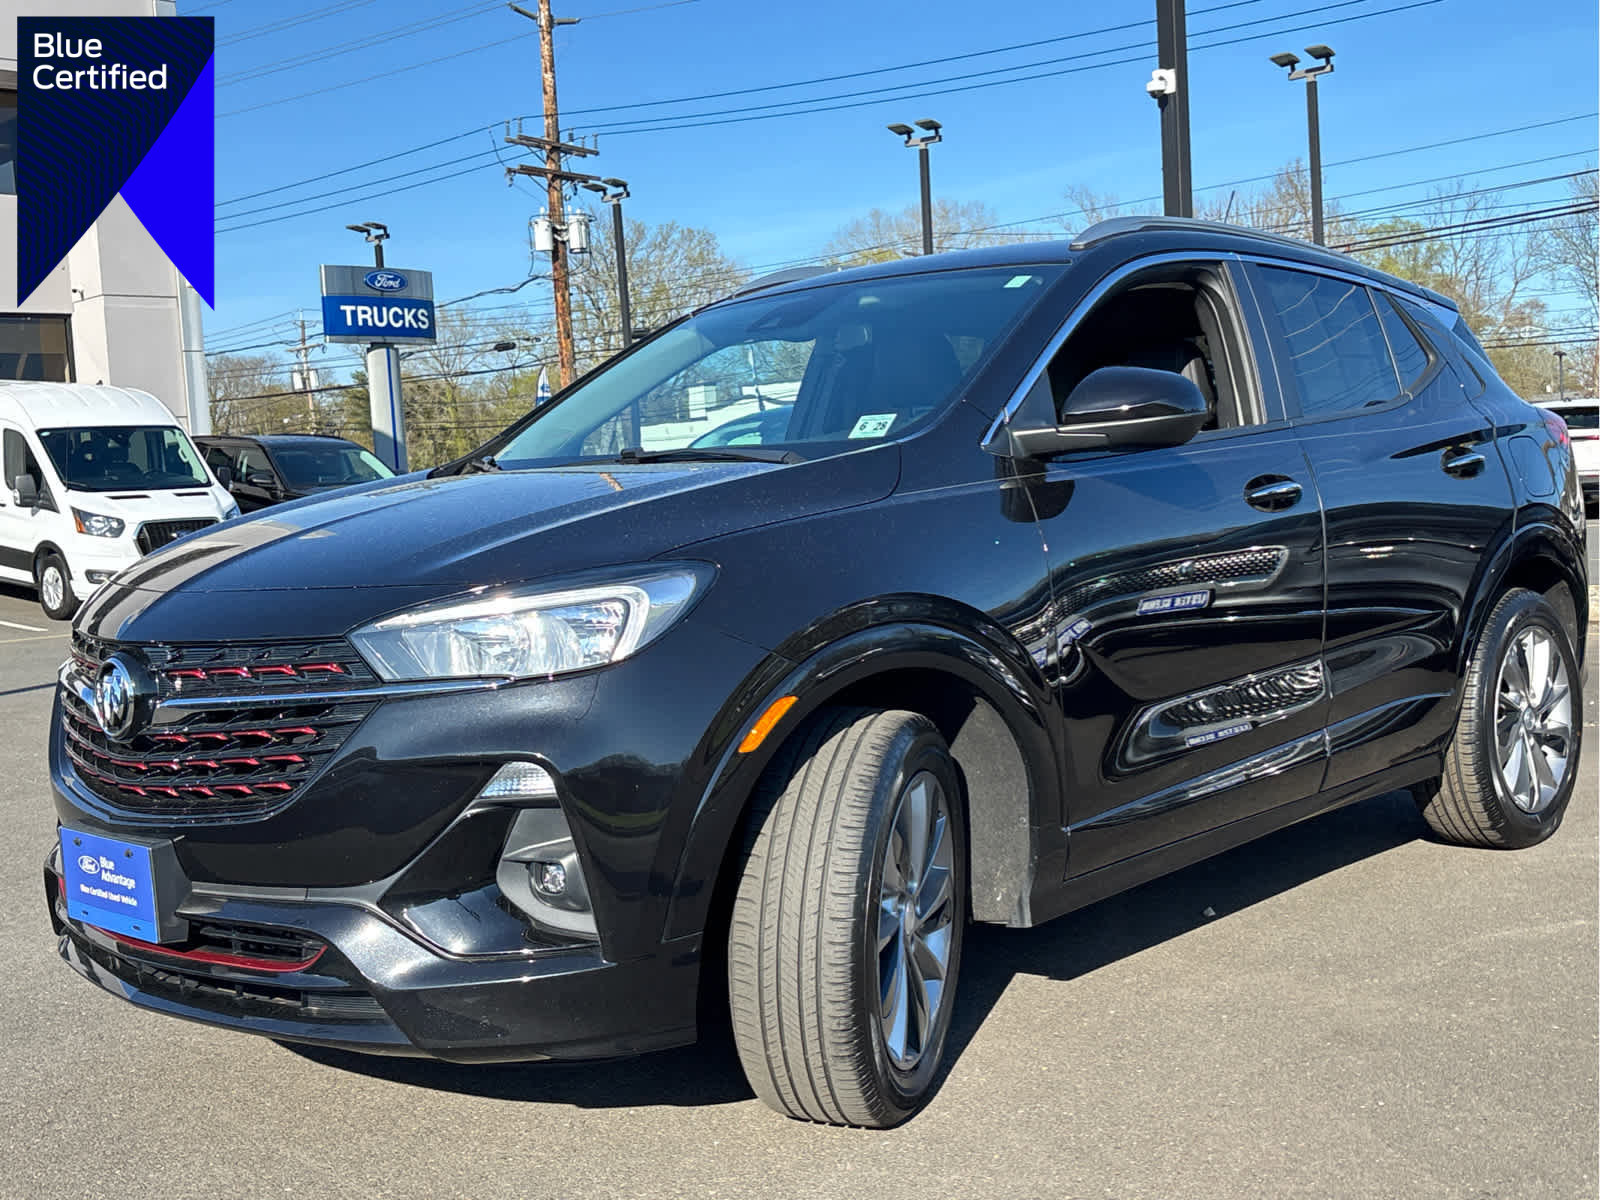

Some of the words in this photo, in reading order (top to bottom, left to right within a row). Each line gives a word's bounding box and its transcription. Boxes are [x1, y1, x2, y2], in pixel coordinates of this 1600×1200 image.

[374, 273, 401, 289] Ford
[340, 304, 430, 330] TRUCKS
[81, 857, 96, 872] Ford
[99, 855, 115, 870] Blue
[101, 869, 136, 890] Advantage
